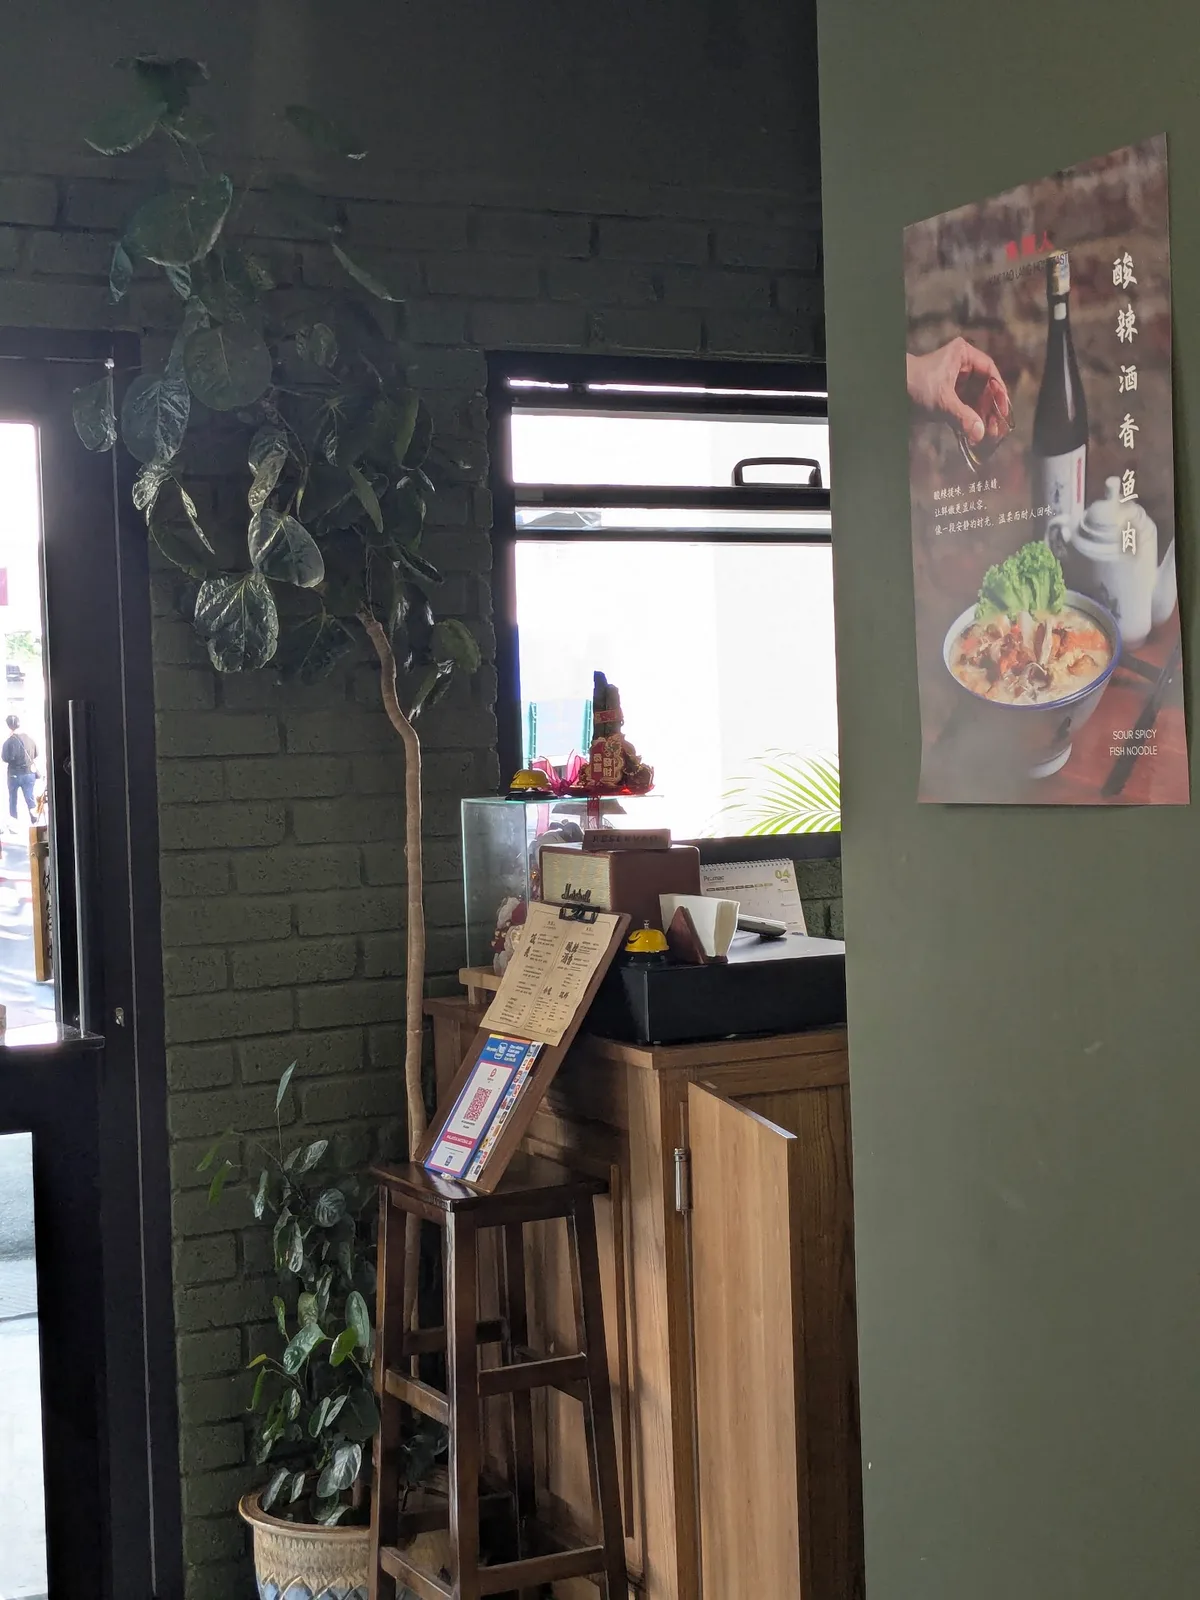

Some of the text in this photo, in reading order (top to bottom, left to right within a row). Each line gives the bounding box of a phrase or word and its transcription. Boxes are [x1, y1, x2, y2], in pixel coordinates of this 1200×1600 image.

[1112, 252, 1139, 555] 酸辣酒香鱼肉
[1112, 729, 1157, 740] SOUR SPICY
[1109, 745, 1158, 757] FISH NOODLE
[774, 869, 791, 880] 04
